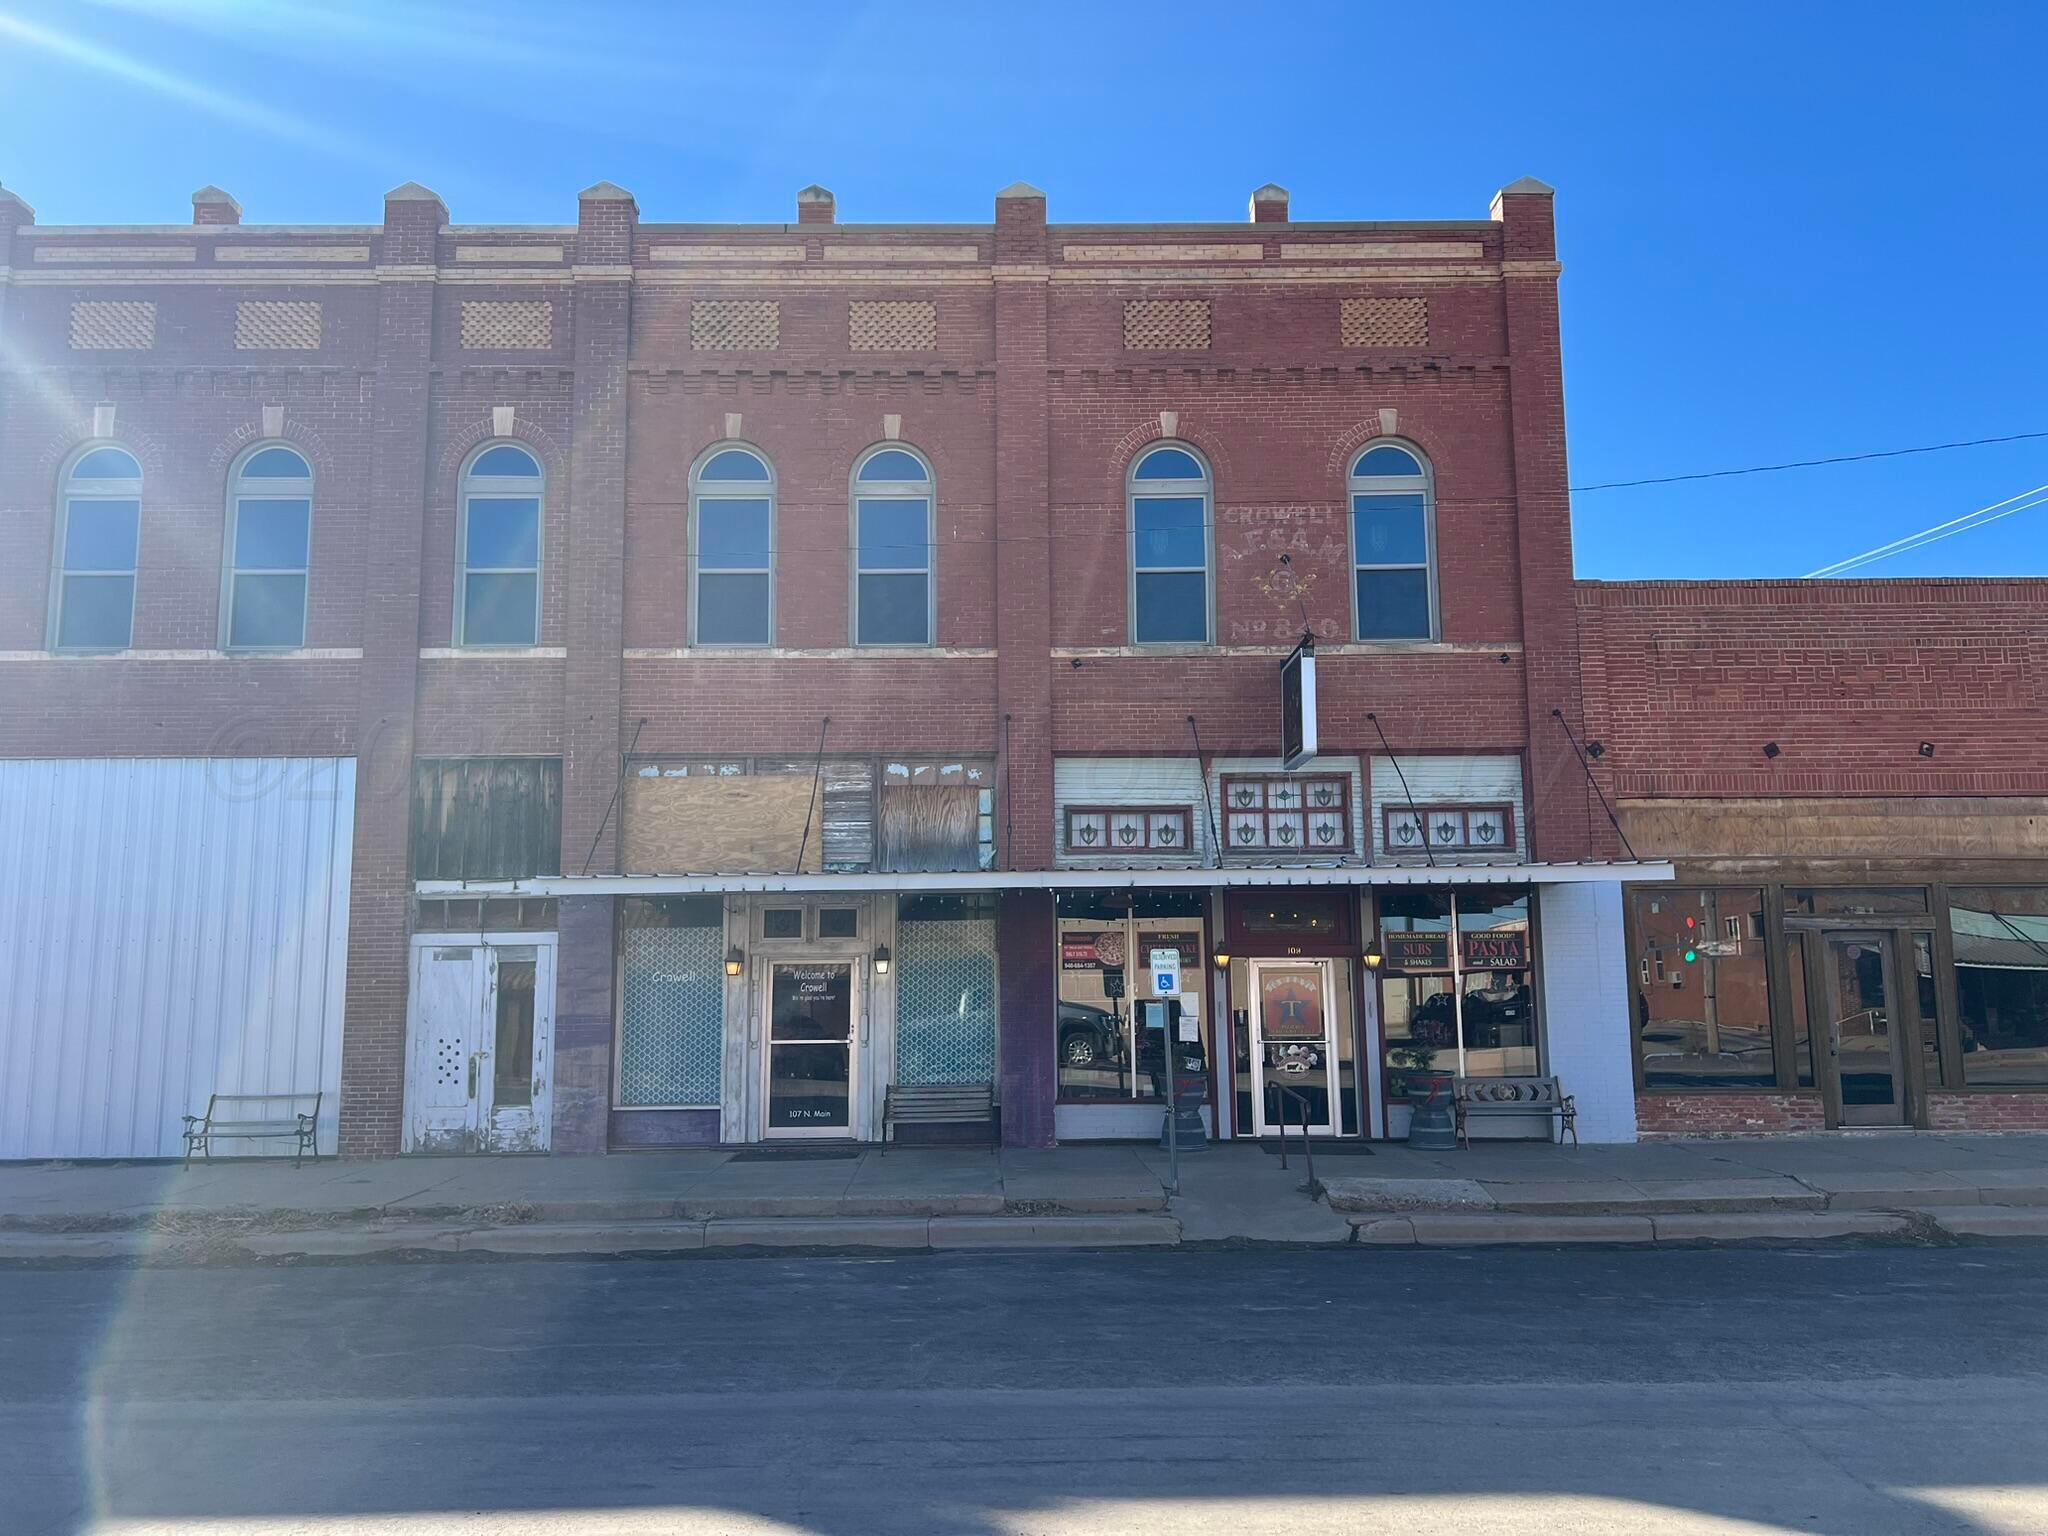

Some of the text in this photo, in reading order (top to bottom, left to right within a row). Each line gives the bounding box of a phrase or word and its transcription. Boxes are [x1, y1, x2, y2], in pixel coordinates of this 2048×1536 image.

[1403, 943, 1432, 955] SUBS
[1470, 941, 1519, 956] PASTA
[1152, 952, 1178, 960] RESERVED
[1154, 962, 1177, 970] PARKING
[1490, 958, 1517, 967] SALAD
[652, 970, 697, 982] Crowell
[793, 970, 835, 980] Welcome to
[800, 982, 827, 992] Crowell
[789, 1110, 802, 1118] 107
[814, 1109, 831, 1118] Main
